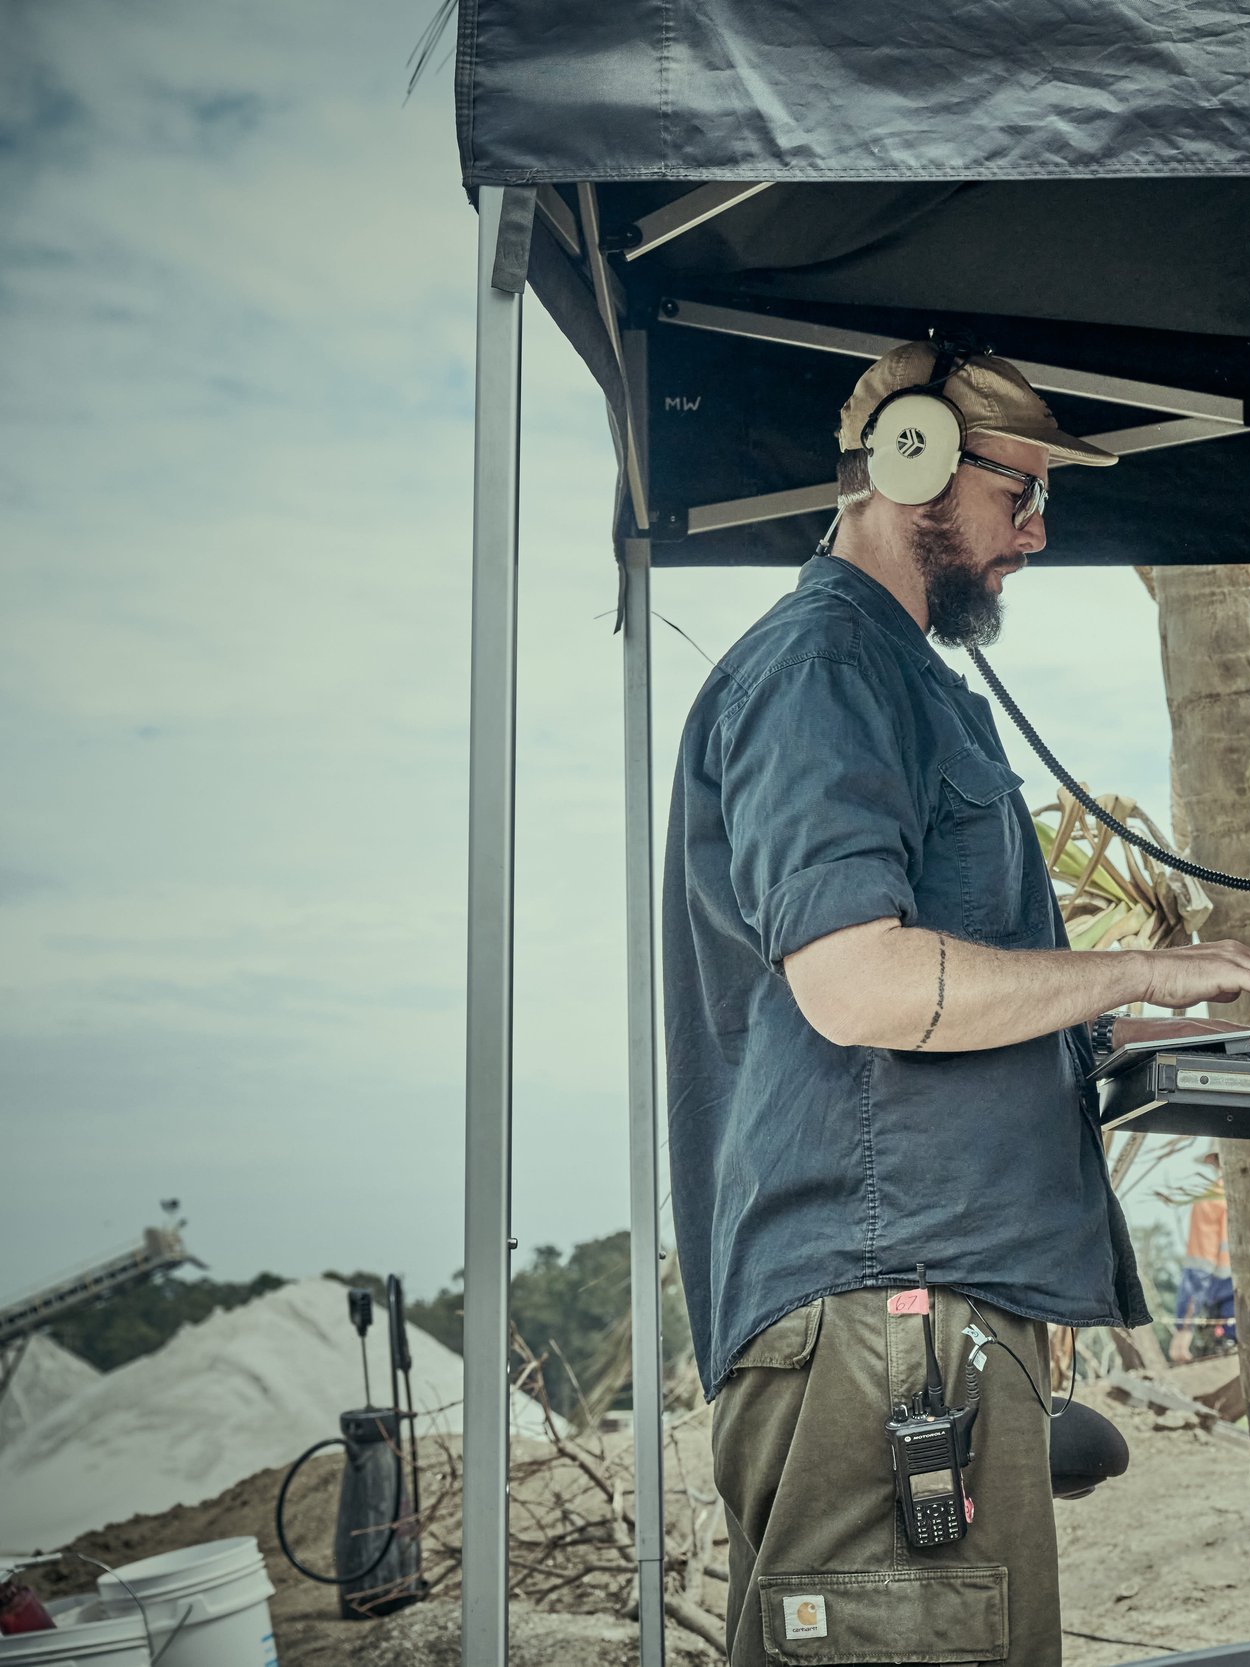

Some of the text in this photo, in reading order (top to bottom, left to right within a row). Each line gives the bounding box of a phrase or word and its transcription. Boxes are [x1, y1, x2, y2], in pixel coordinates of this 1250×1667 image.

[665, 396, 701, 411] MW
[895, 1295, 918, 1311] 67
[913, 1430, 946, 1441] MOTOROLA
